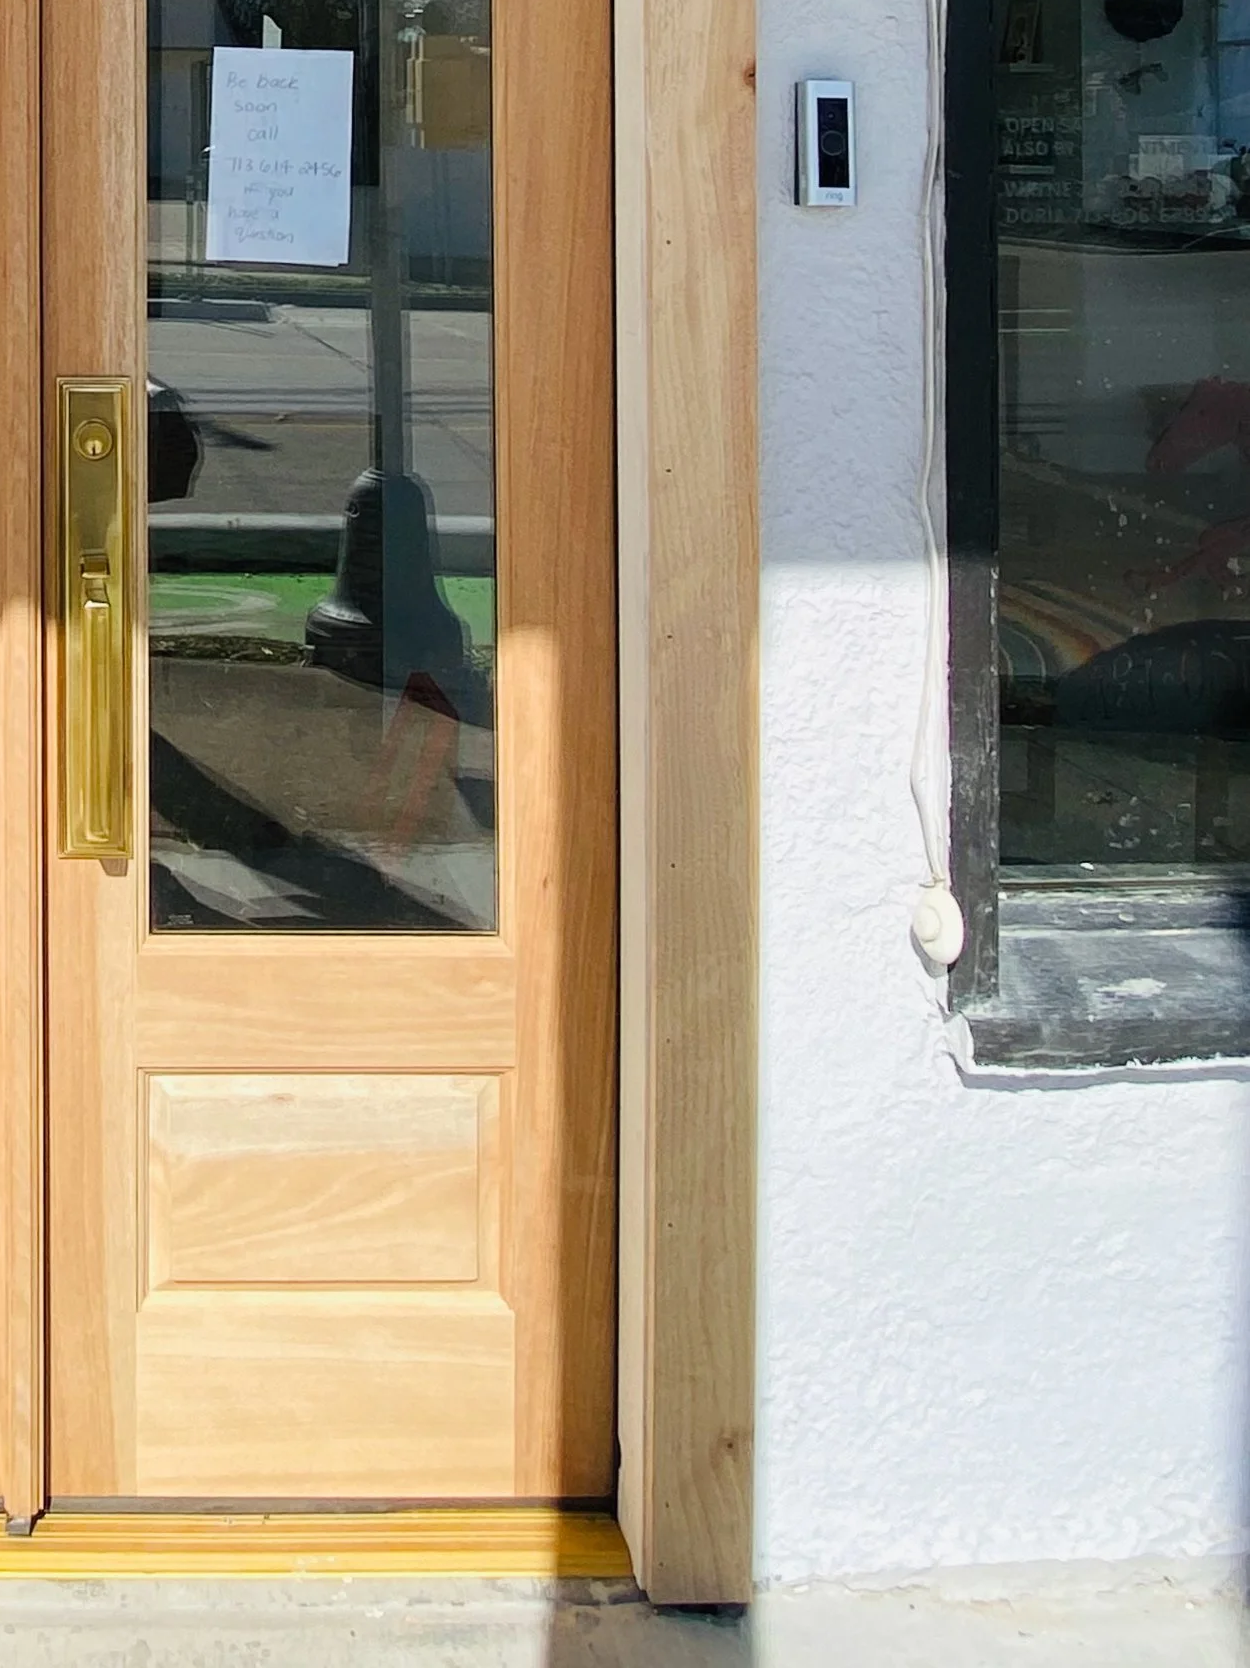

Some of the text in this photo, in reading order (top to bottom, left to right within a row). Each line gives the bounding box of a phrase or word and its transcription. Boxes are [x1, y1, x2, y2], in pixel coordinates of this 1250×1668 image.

[226, 71, 300, 90] Be back
[234, 100, 278, 113] soon
[246, 124, 279, 142] call
